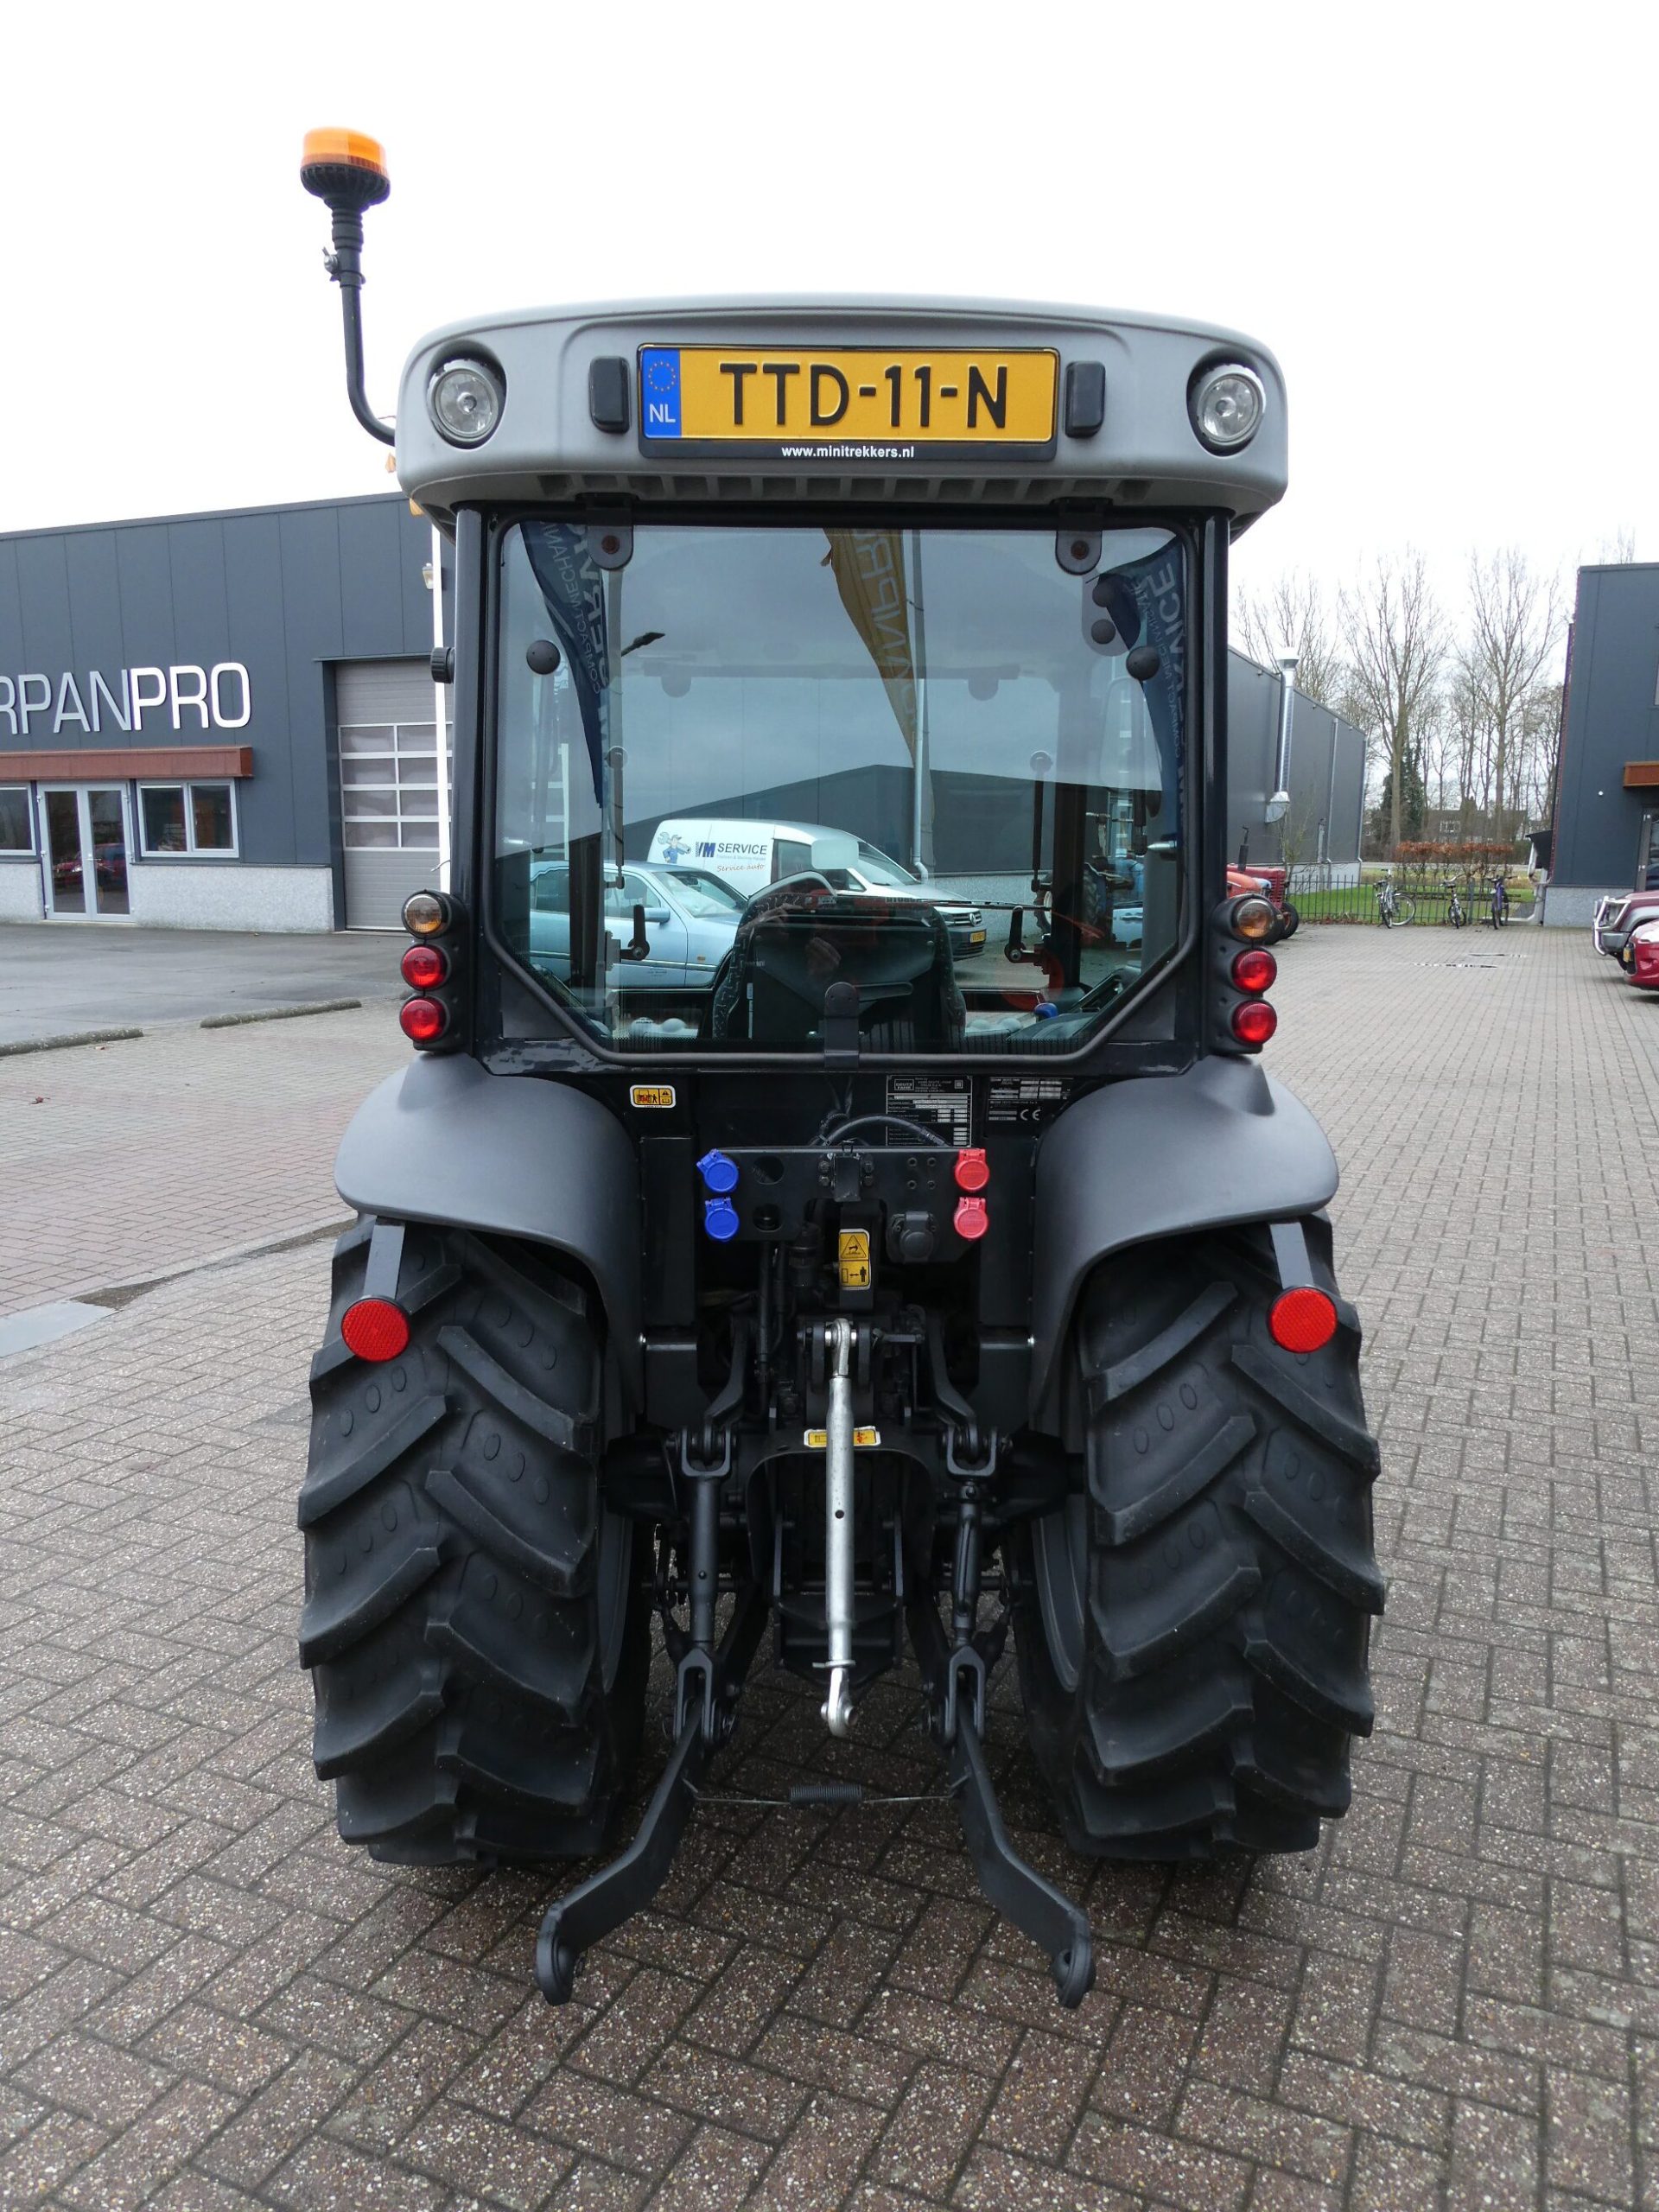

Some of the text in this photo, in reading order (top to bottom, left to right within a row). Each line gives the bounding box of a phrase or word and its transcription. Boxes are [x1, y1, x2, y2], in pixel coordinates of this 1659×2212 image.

[719, 362, 1008, 429] TTD-11-N
[649, 404, 677, 423] NL
[781, 445, 915, 458] www.minitrekkers.nl
[717, 842, 767, 855] SERVICE
